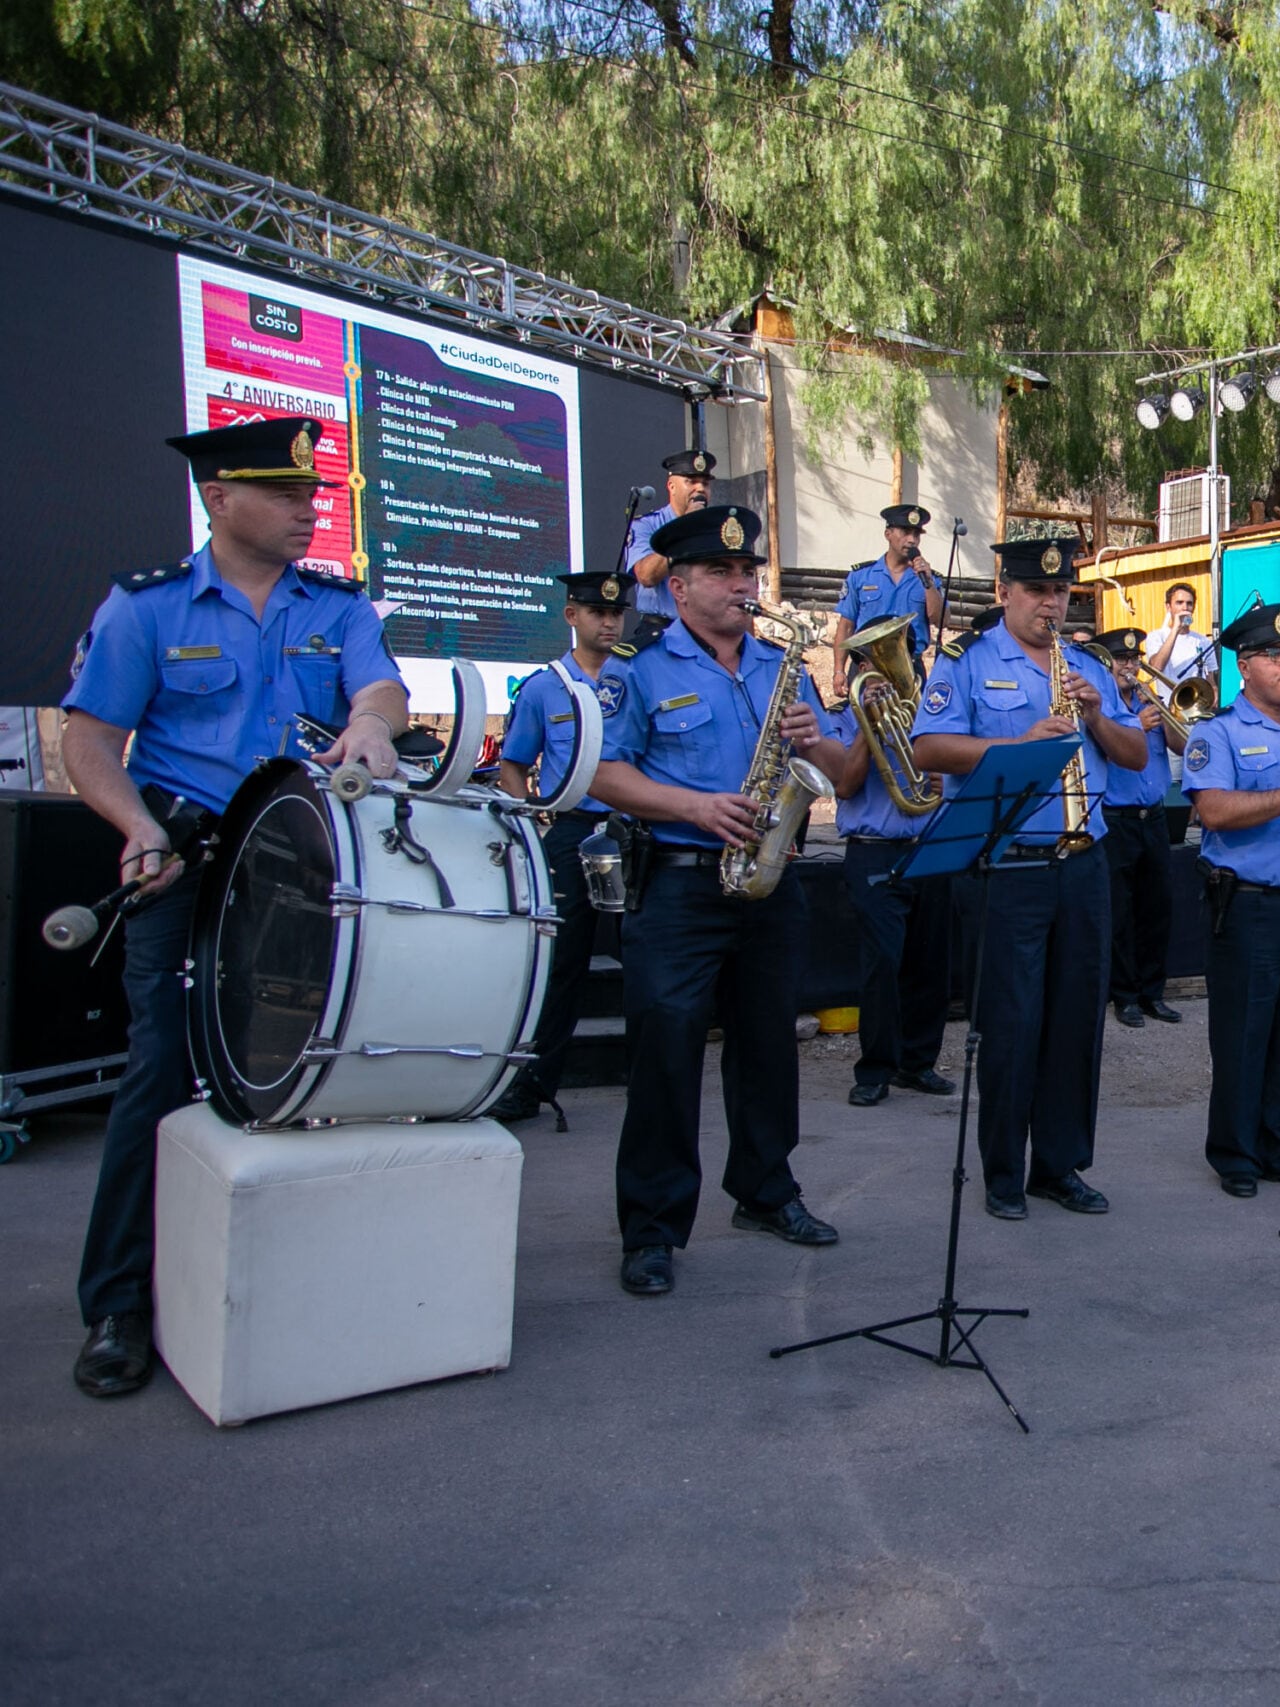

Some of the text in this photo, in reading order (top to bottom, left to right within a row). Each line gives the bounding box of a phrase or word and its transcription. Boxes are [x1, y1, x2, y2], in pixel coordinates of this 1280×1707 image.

[265, 303, 287, 319] SIN
[255, 313, 298, 334] COSTO
[231, 336, 248, 350] Con
[248, 341, 294, 361] inscripción
[440, 343, 560, 385] #CiudadDelDeporte
[405, 392, 414, 403] de
[420, 381, 438, 394] playa
[439, 385, 448, 396] de
[243, 385, 336, 420] ANIVERSARIO
[405, 407, 415, 418] de
[415, 410, 430, 422] trail
[406, 422, 415, 434] de
[416, 426, 445, 441] trekking
[406, 438, 416, 449] de
[442, 447, 451, 456] en
[407, 454, 417, 464] de
[417, 455, 446, 471] trekking
[384, 495, 430, 512] Presentación
[430, 502, 439, 513] de
[440, 505, 468, 518] Proyecto
[469, 509, 489, 520] Fondo
[511, 516, 519, 526] de
[421, 516, 453, 530] Prohibido
[453, 521, 463, 532] NO
[464, 523, 483, 534] JUGAR
[416, 562, 440, 573] stands
[477, 568, 492, 579] food
[545, 576, 554, 586] de
[461, 581, 470, 591] de
[470, 581, 494, 593] Escuela
[524, 587, 532, 598] de
[425, 594, 430, 603] y
[502, 600, 511, 610] de
[538, 603, 547, 613] de
[402, 606, 435, 618] Recorrido
[435, 610, 440, 619] y
[440, 609, 463, 620] mucho
